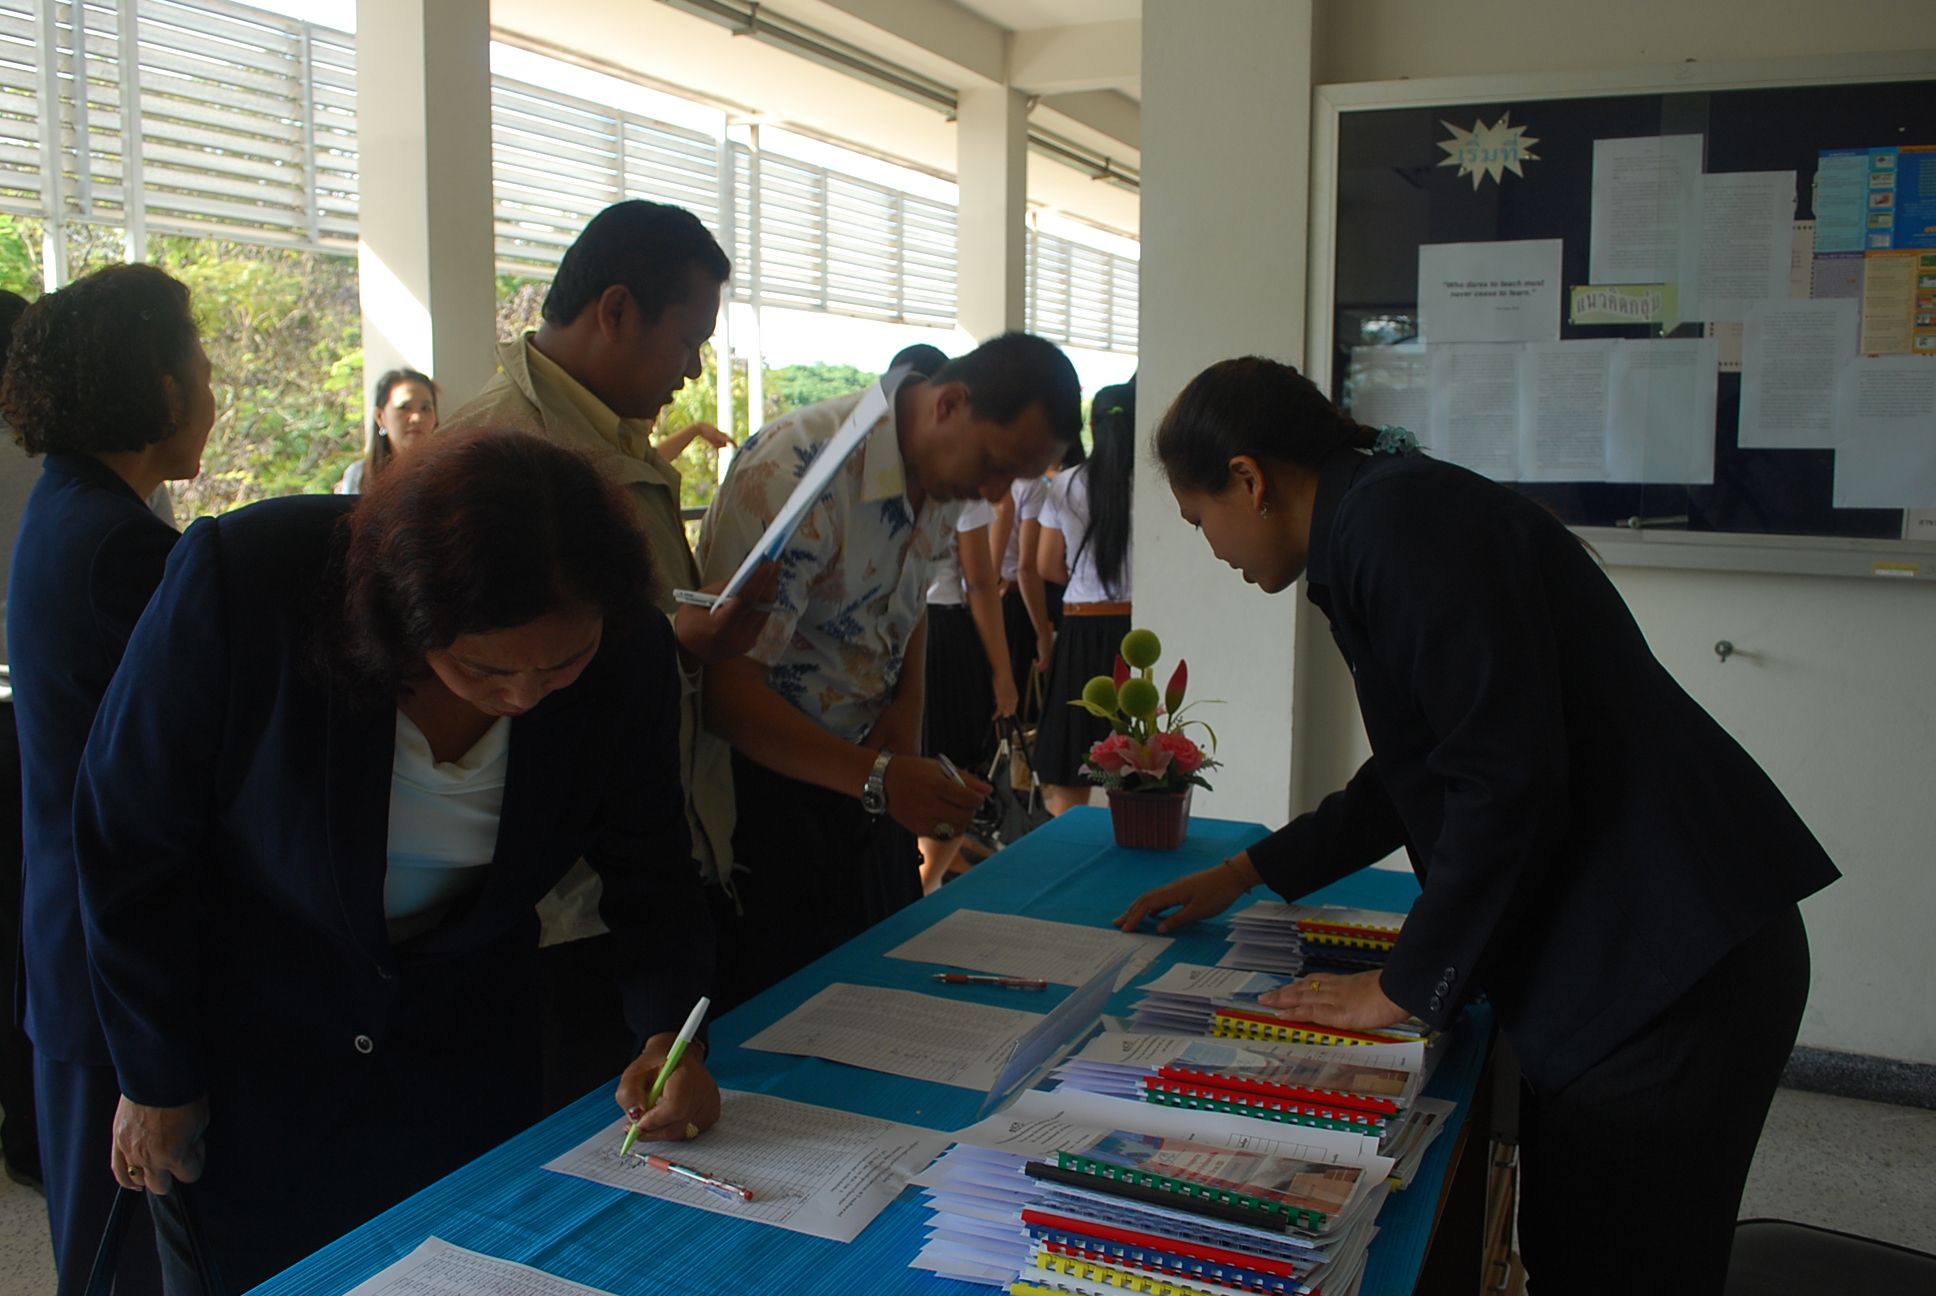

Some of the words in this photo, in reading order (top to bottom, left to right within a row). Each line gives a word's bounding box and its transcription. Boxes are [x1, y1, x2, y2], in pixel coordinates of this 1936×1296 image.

[1576, 286, 1660, 320] แนวคิดกลุ่ม
